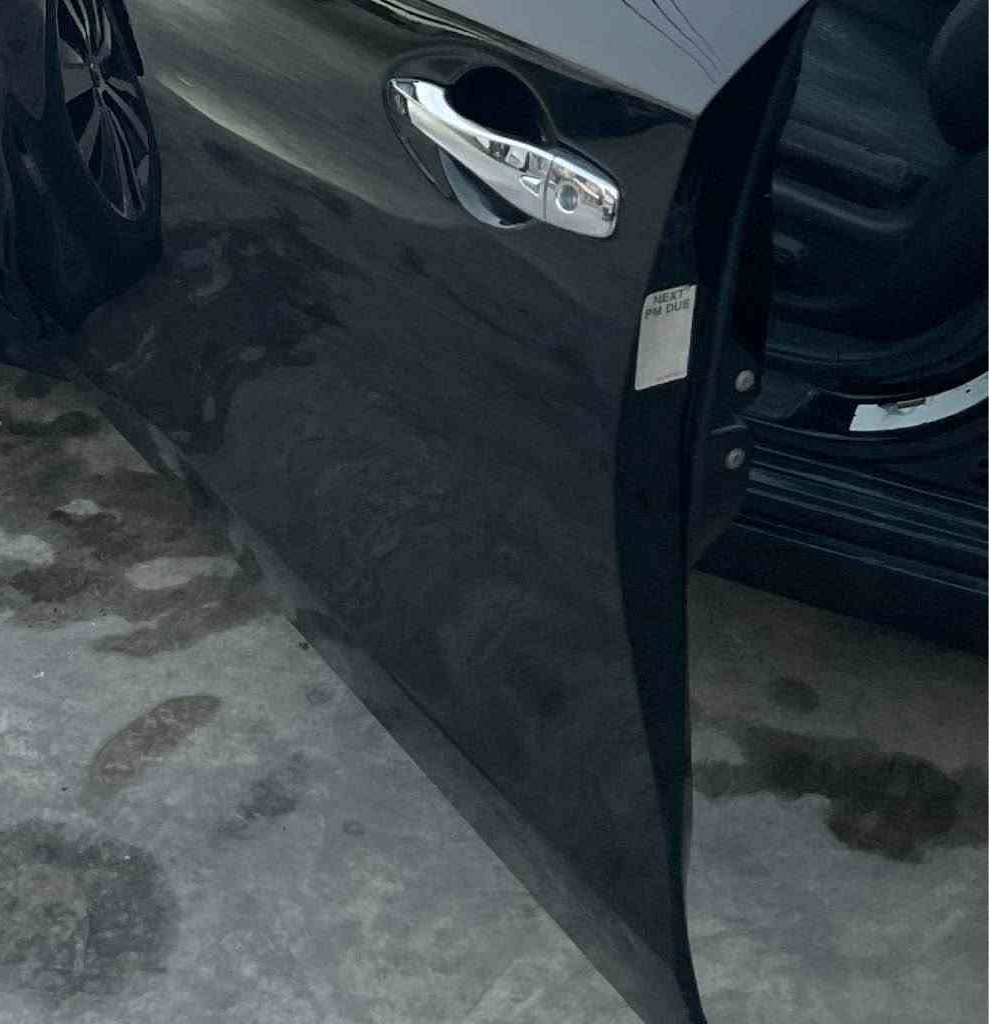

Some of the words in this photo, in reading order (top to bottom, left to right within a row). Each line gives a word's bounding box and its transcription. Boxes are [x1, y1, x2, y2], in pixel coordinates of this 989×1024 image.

[654, 289, 684, 305] NEXT
[644, 306, 663, 319] PM
[666, 299, 691, 313] DUE
